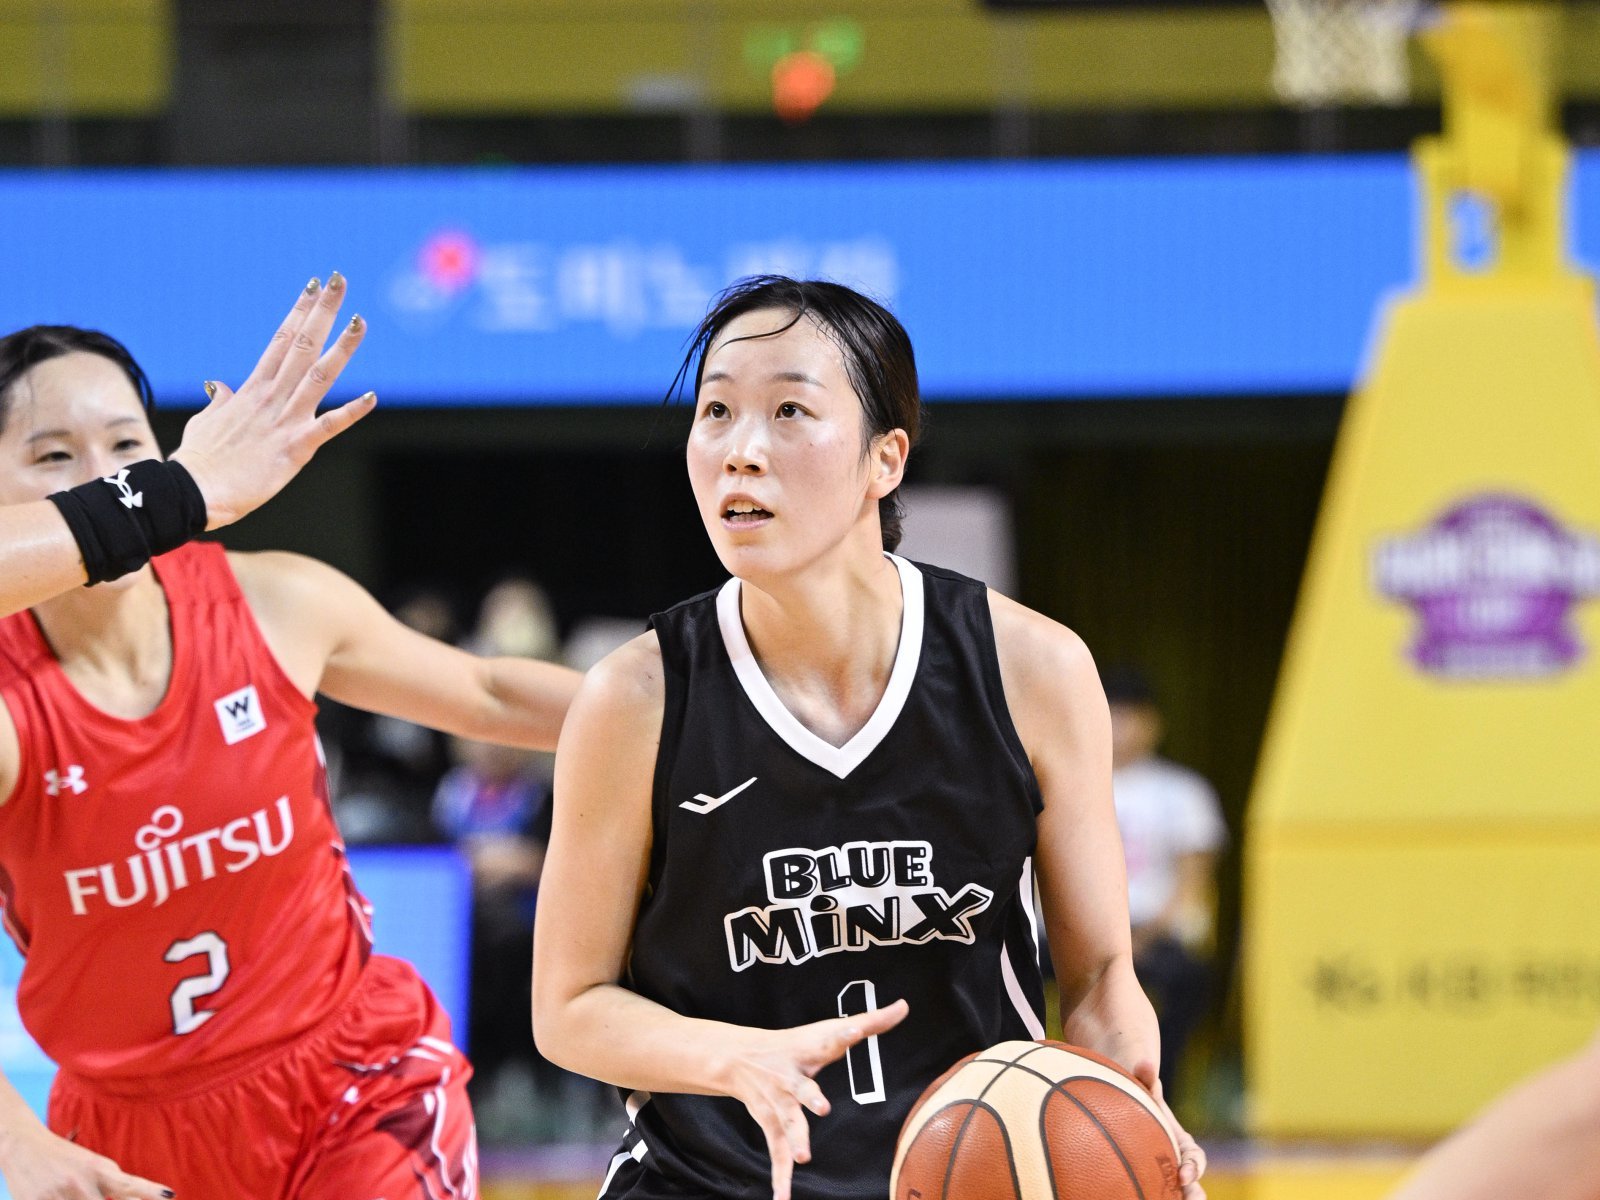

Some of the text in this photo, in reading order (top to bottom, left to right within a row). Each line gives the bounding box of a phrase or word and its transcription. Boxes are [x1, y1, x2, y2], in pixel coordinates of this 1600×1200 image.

[224, 696, 249, 719] W
[64, 796, 294, 915] FUJITSU
[763, 840, 933, 902] BLUE
[163, 930, 231, 1036] 2
[837, 980, 886, 1105] 1
